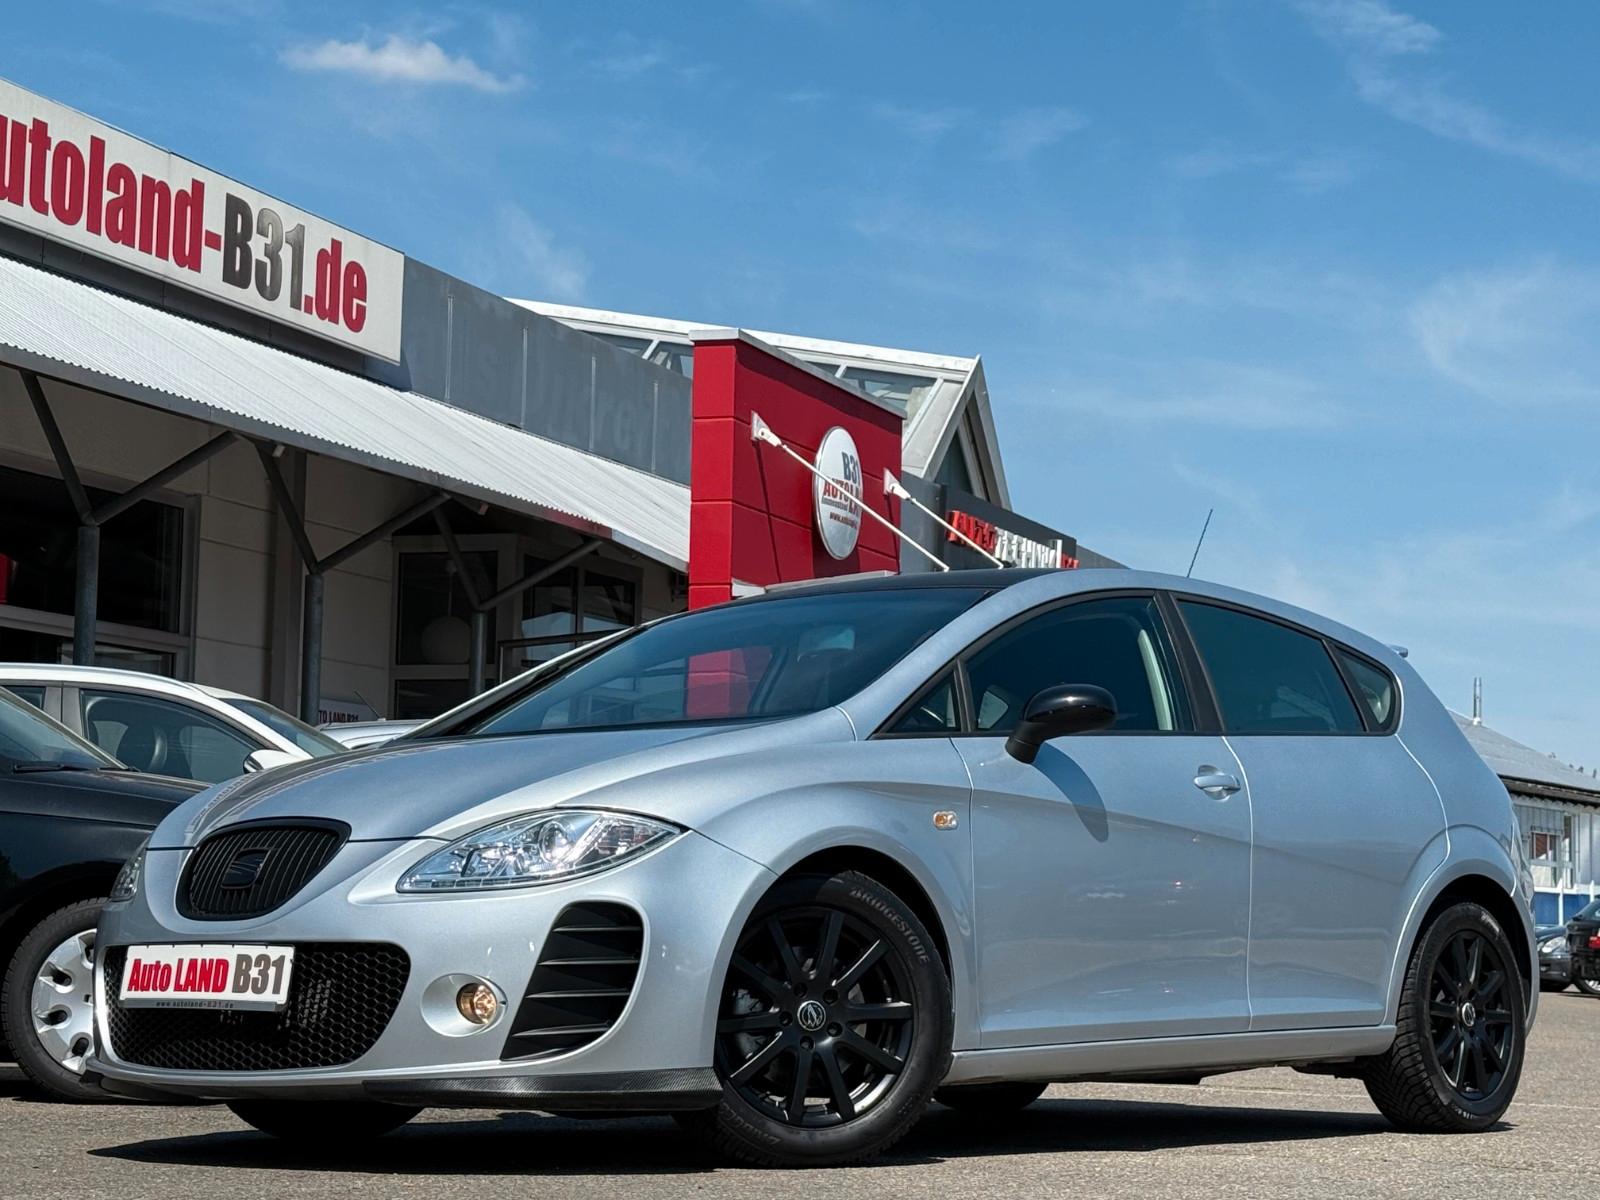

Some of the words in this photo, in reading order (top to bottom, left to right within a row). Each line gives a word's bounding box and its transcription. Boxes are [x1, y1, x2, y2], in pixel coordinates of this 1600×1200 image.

[127, 958, 172, 992] Auto
[173, 958, 229, 993] LAND
[232, 953, 286, 995] B31
